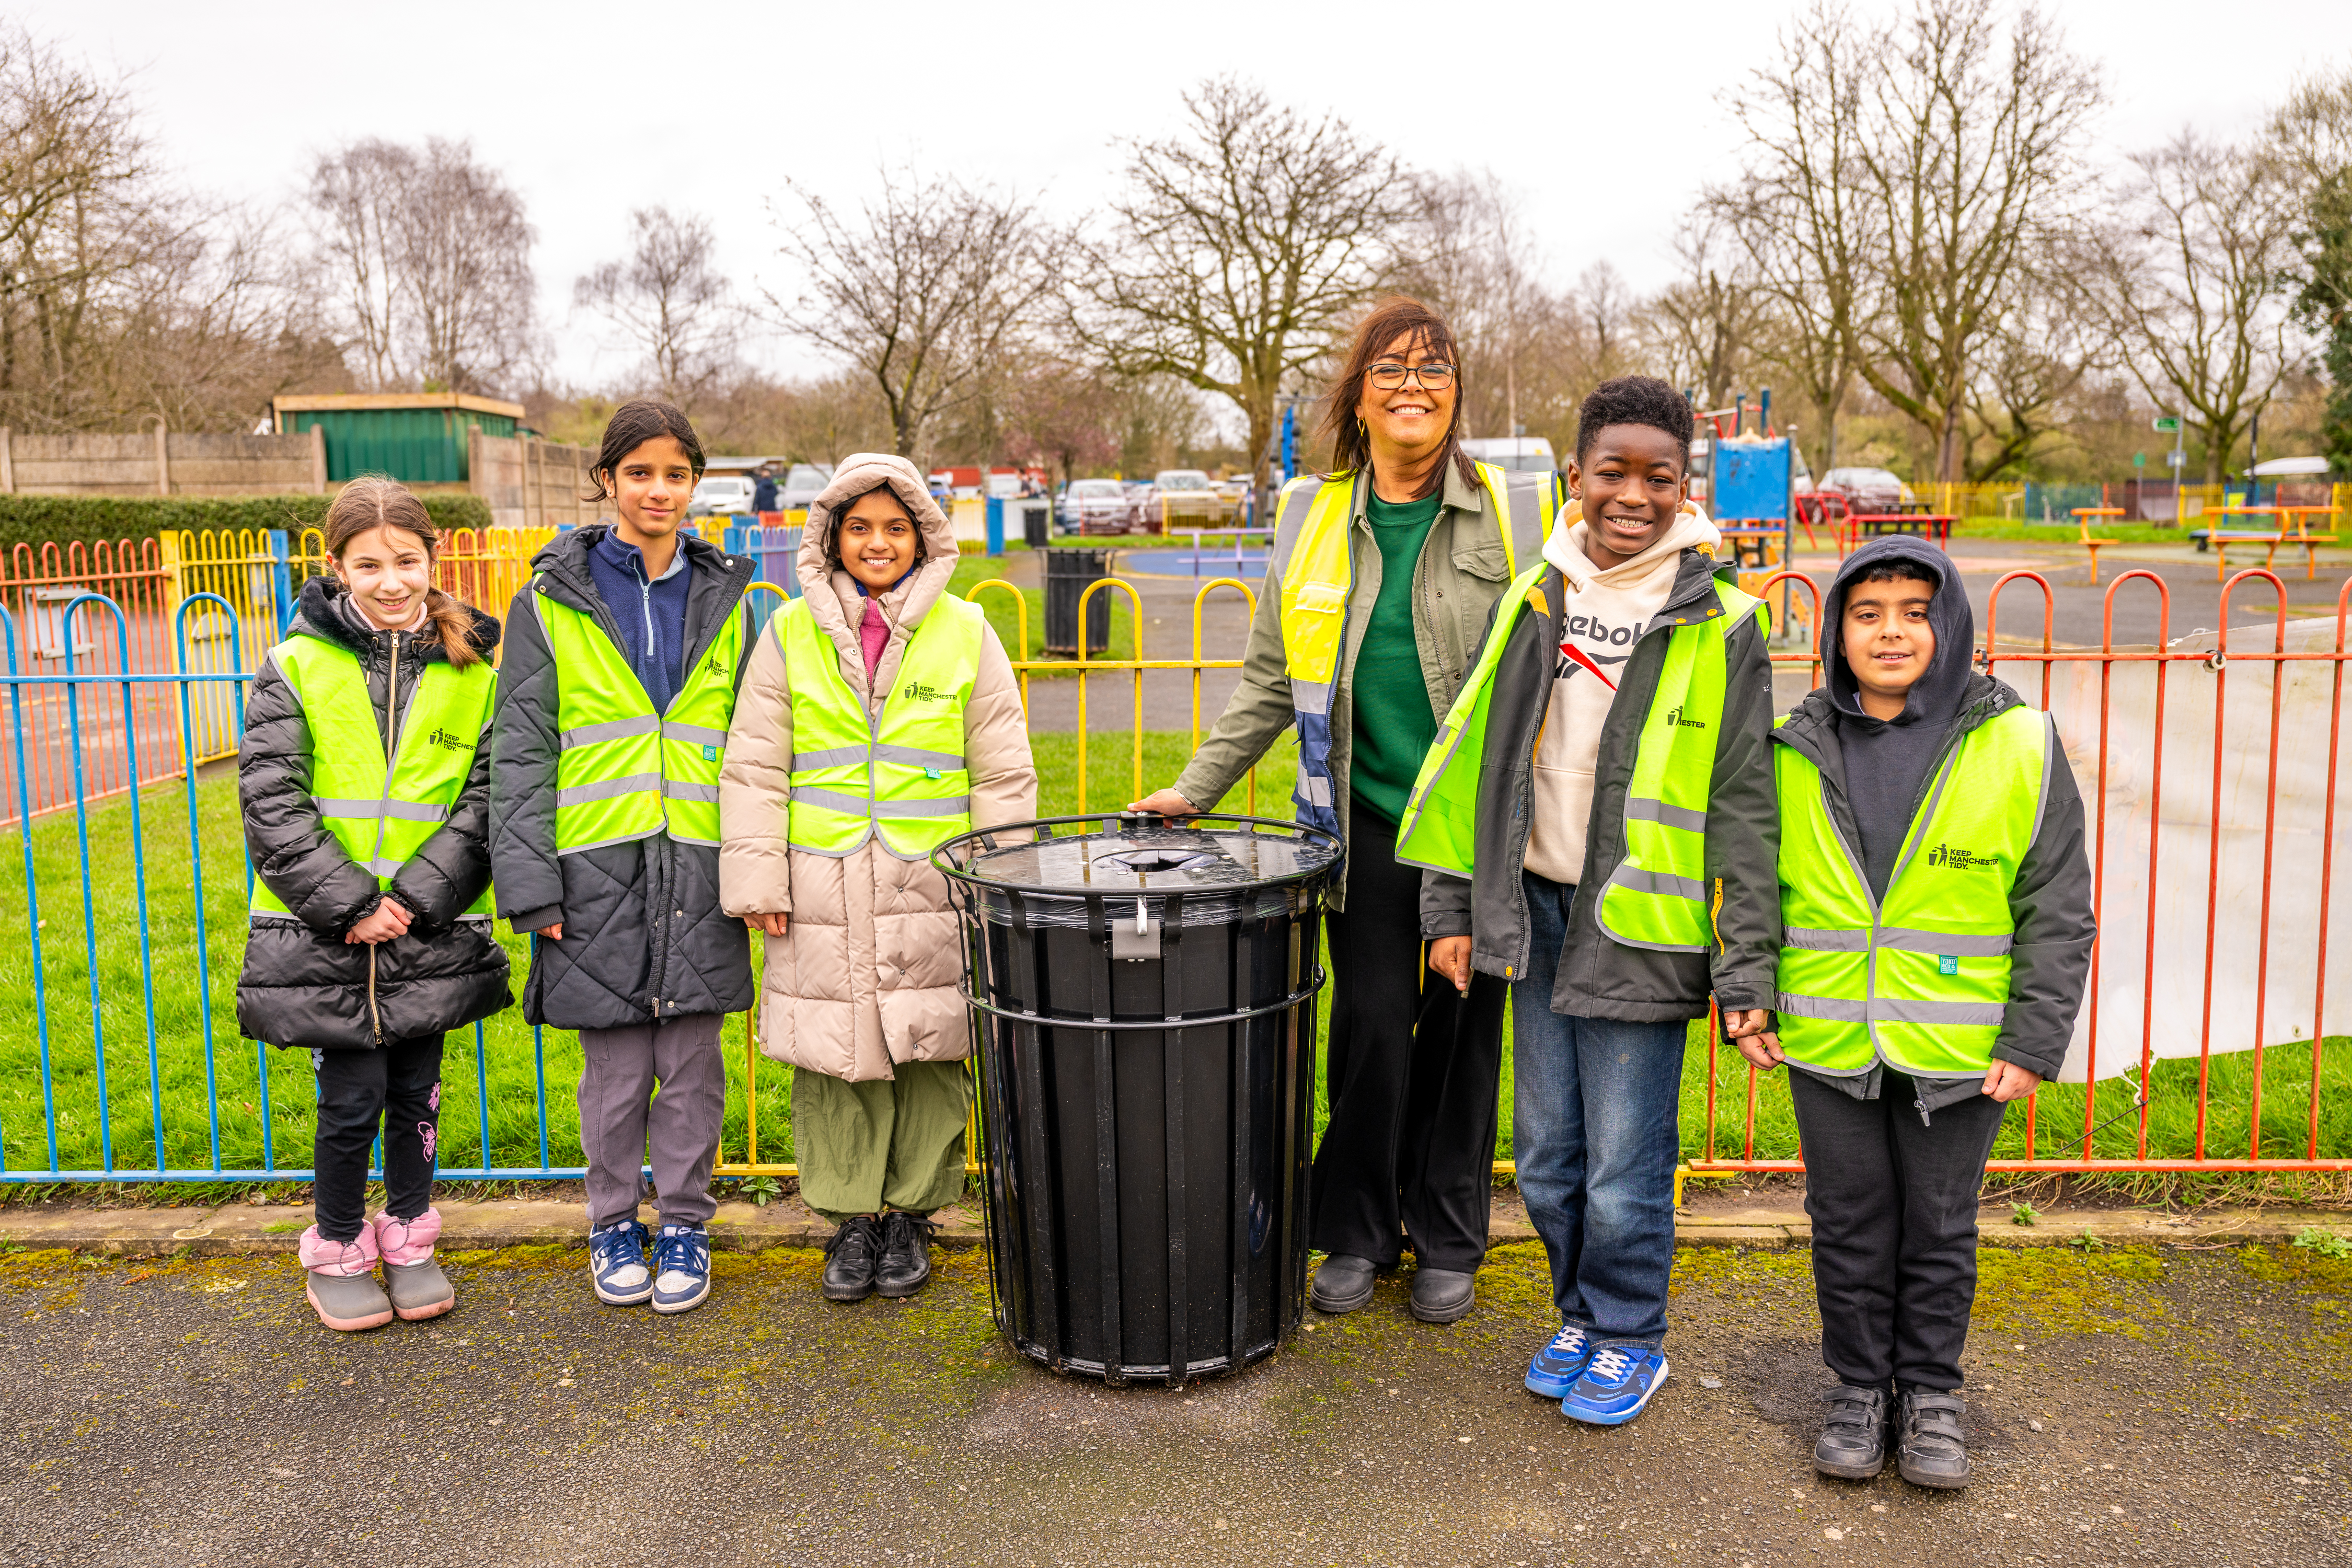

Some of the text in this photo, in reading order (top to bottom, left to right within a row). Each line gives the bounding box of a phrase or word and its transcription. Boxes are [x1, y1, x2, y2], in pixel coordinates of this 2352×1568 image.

[444, 743, 456, 752] TIDY.
[1949, 856, 1999, 866] MANCHESTER
[1949, 861, 1968, 870] TIDY.
